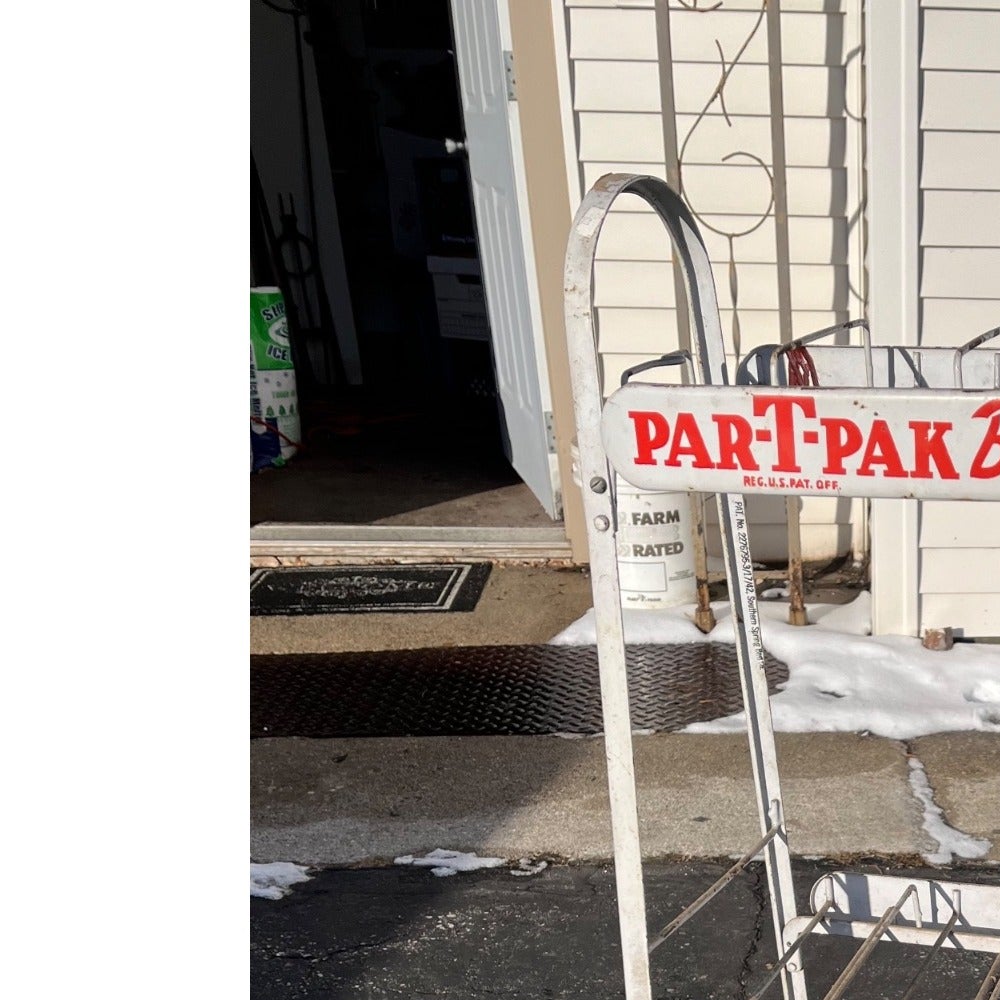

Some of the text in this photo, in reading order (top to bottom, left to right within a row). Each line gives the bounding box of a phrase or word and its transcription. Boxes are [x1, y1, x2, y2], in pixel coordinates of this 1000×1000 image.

[267, 345, 288, 361] ICE
[628, 395, 961, 481] PAR-T-PAK
[631, 509, 681, 526] FARM
[632, 541, 684, 557] RATED
[735, 501, 744, 517] PAT.
[746, 596, 758, 625] Southern
